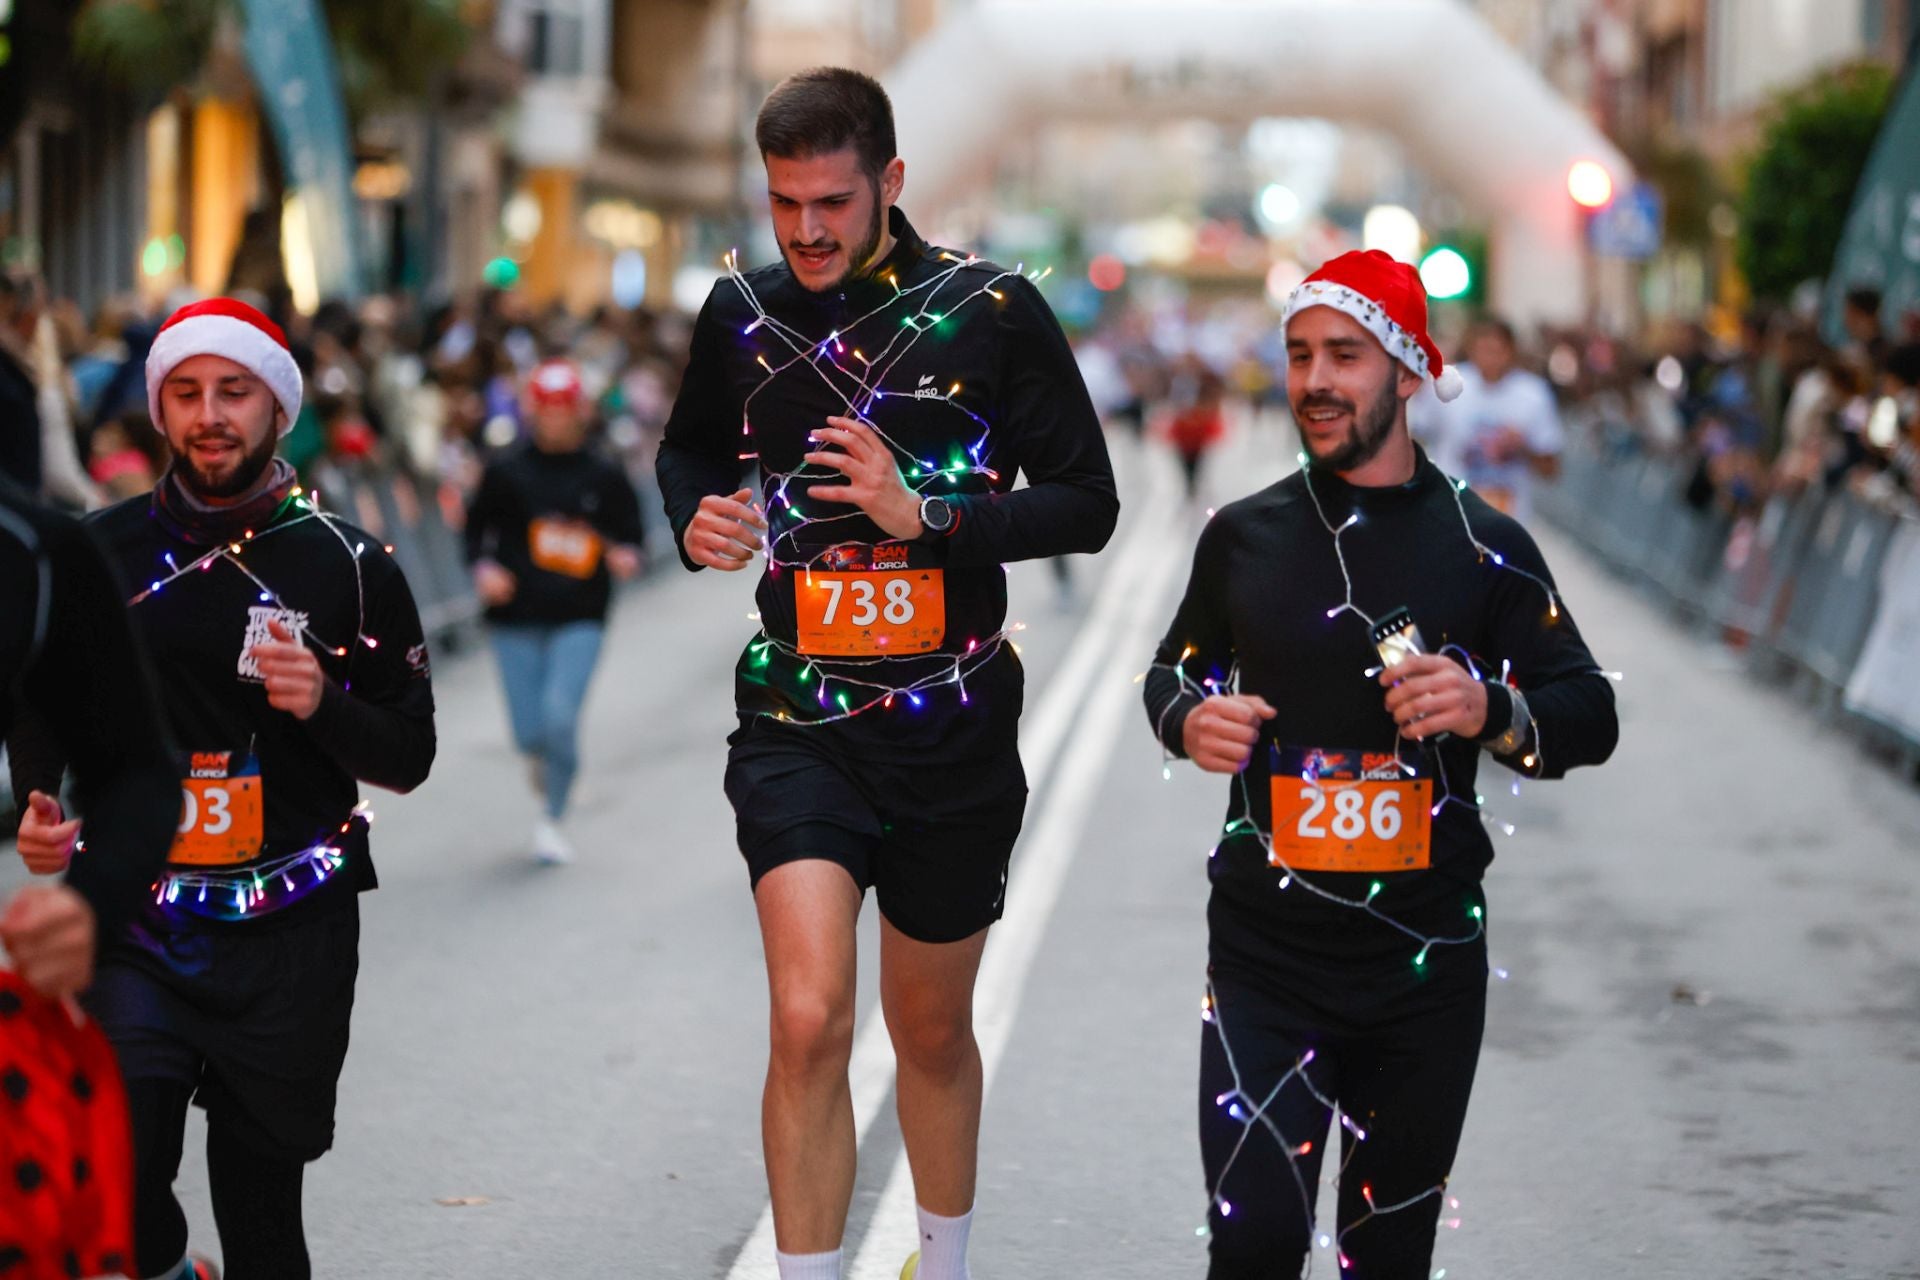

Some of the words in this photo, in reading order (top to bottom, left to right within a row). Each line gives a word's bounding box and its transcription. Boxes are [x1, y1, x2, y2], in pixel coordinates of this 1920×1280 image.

[872, 546, 909, 558] SAN
[872, 561, 909, 570] LORCA
[819, 578, 915, 626] 738
[191, 752, 230, 767] SAN
[190, 769, 228, 778] LORCA
[1297, 787, 1402, 840] 286
